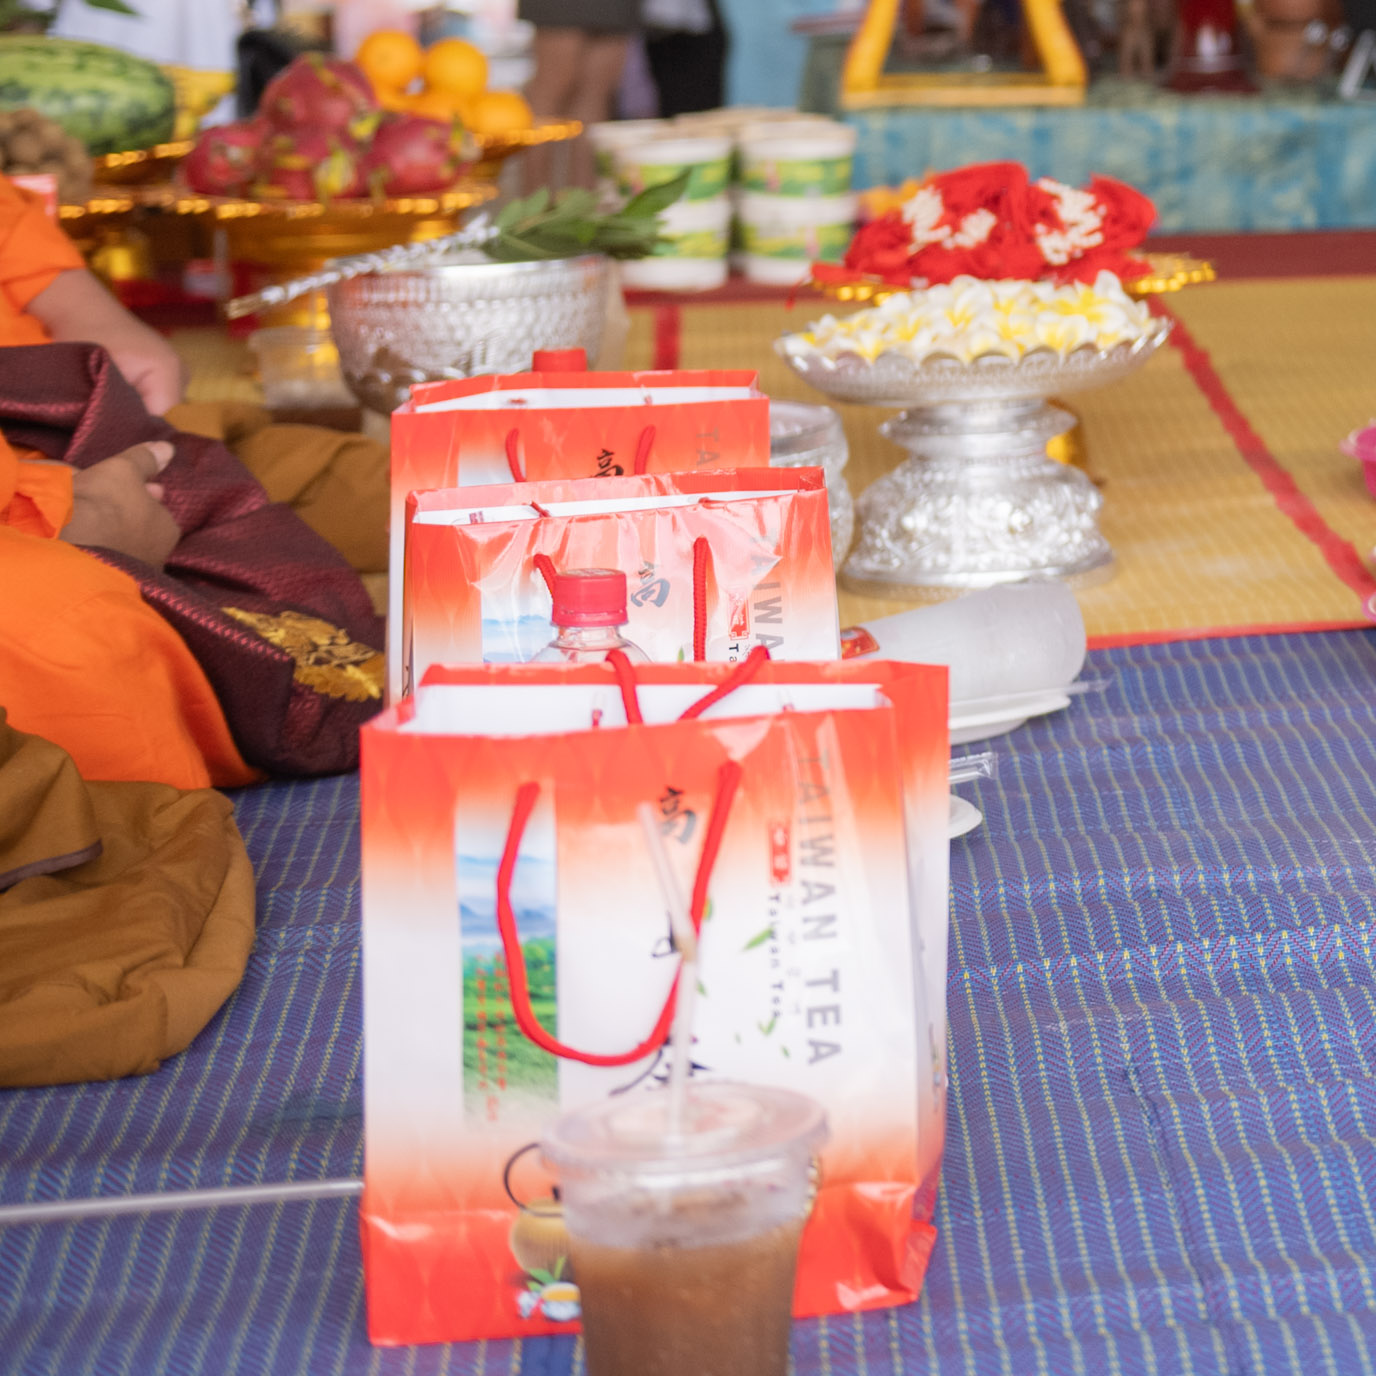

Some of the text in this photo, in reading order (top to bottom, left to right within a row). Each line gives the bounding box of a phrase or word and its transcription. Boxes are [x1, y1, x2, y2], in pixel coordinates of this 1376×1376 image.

[751, 528, 785, 660] TAIWA
[799, 749, 842, 1065] TAIWAN TEA
